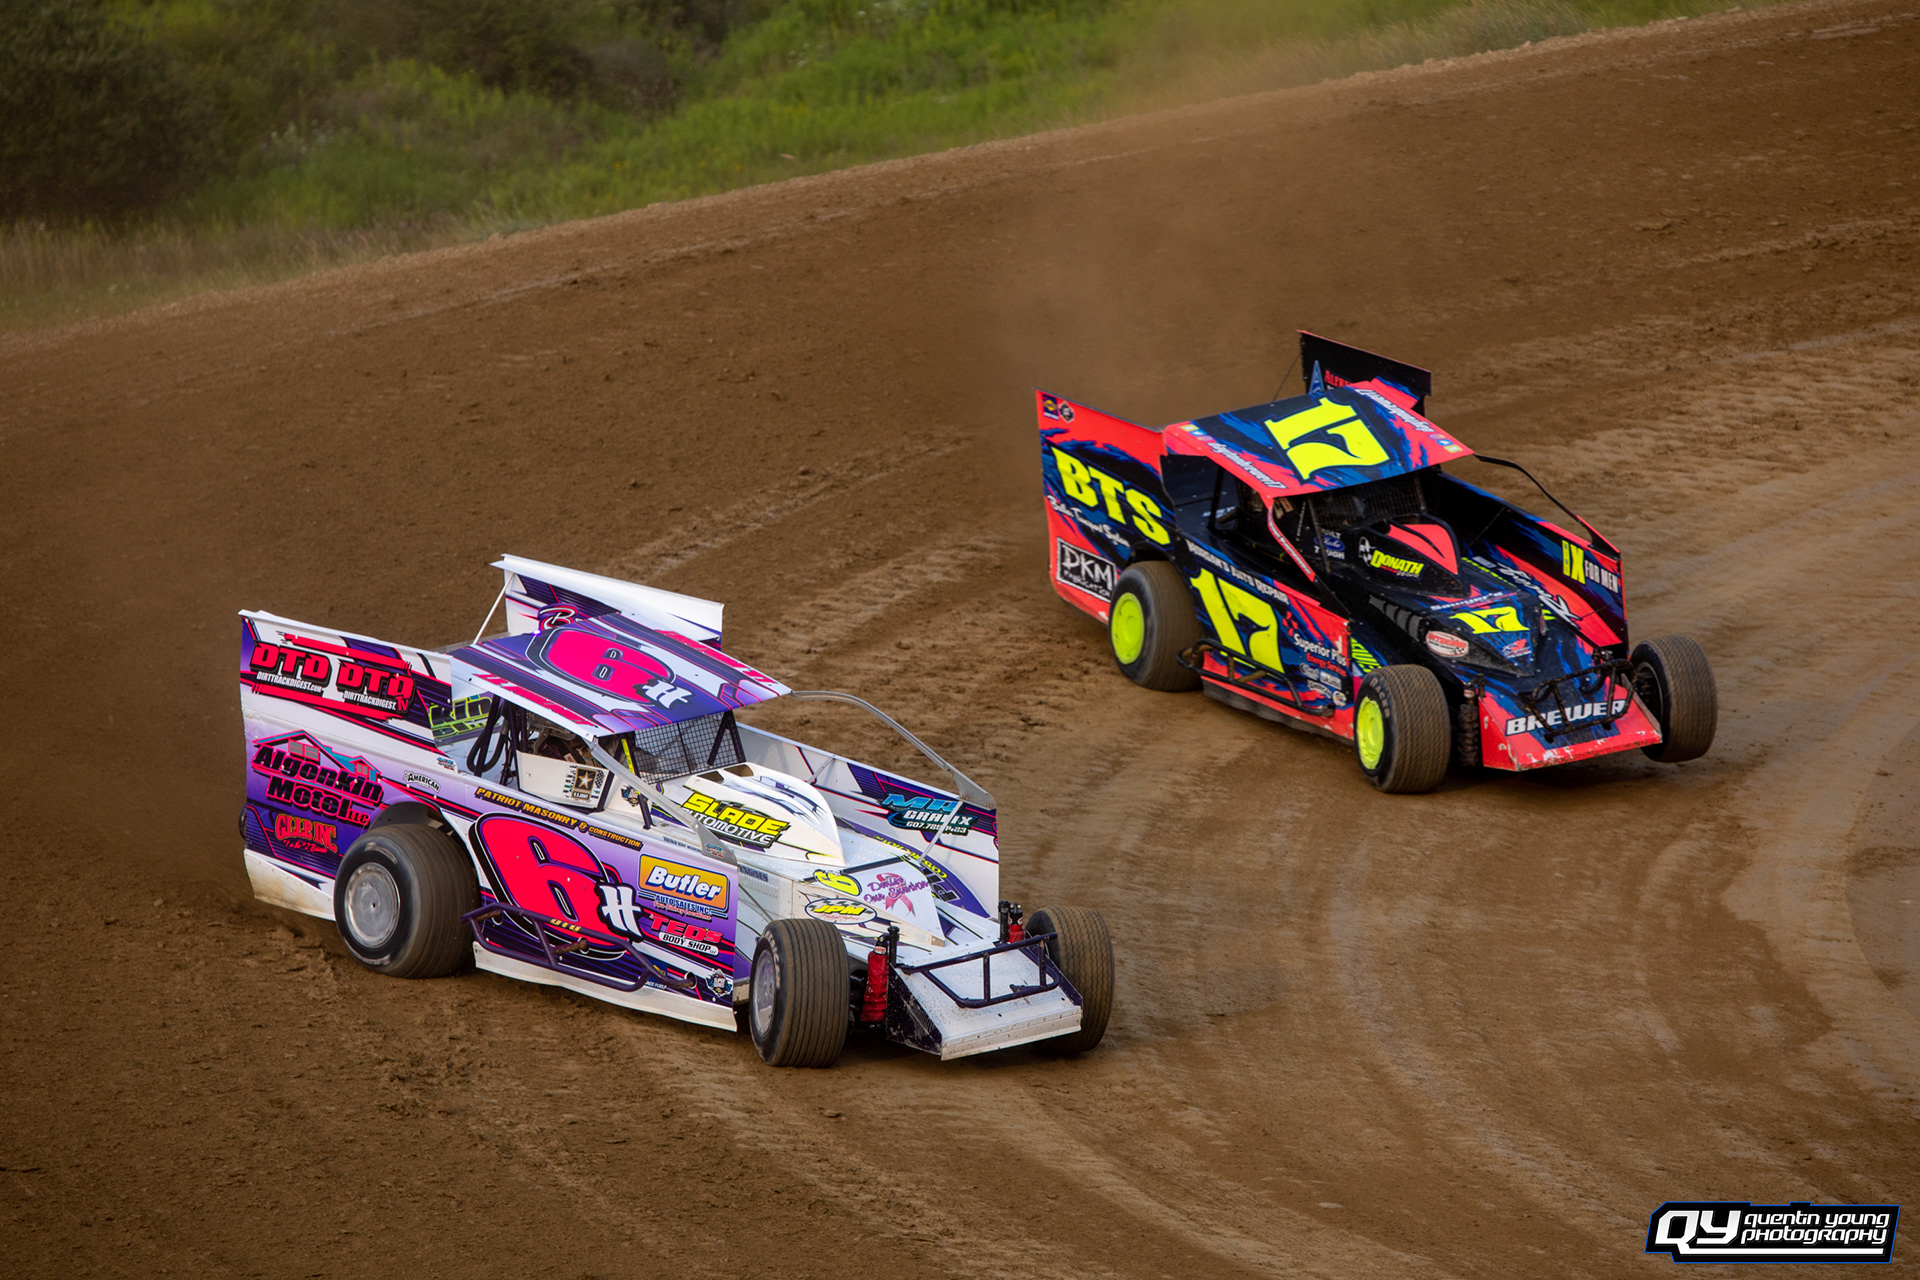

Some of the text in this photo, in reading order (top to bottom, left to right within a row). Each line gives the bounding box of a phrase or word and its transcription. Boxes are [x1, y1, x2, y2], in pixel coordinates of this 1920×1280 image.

[1264, 397, 1390, 481] 17
[1050, 446, 1171, 546] BTS
[1314, 545, 1345, 559] TUGH
[1370, 549, 1424, 574] DONATH
[1585, 560, 1600, 583] FOR
[1601, 568, 1618, 593] MEN
[1190, 567, 1286, 674] 17
[1449, 606, 1530, 634] 17
[250, 641, 331, 680] DTD
[1293, 633, 1330, 658] Superior
[337, 661, 414, 699] DTD
[1506, 700, 1625, 735] BREWER
[251, 745, 383, 803] Algonkin
[407, 773, 440, 791] AMERICAN
[265, 775, 371, 826] Motel LLC
[476, 787, 523, 809] PATRIOT
[522, 803, 578, 827] MASONRY
[578, 822, 589, 832] &
[588, 826, 643, 849] CONSTRUCTION
[683, 792, 789, 836] SLADE
[648, 865, 722, 900] Butler
[655, 895, 674, 905] AUTO
[674, 899, 696, 911] SALES
[814, 904, 866, 915] JPM
[662, 933, 687, 945] BODY
[688, 940, 711, 952] SHOP
